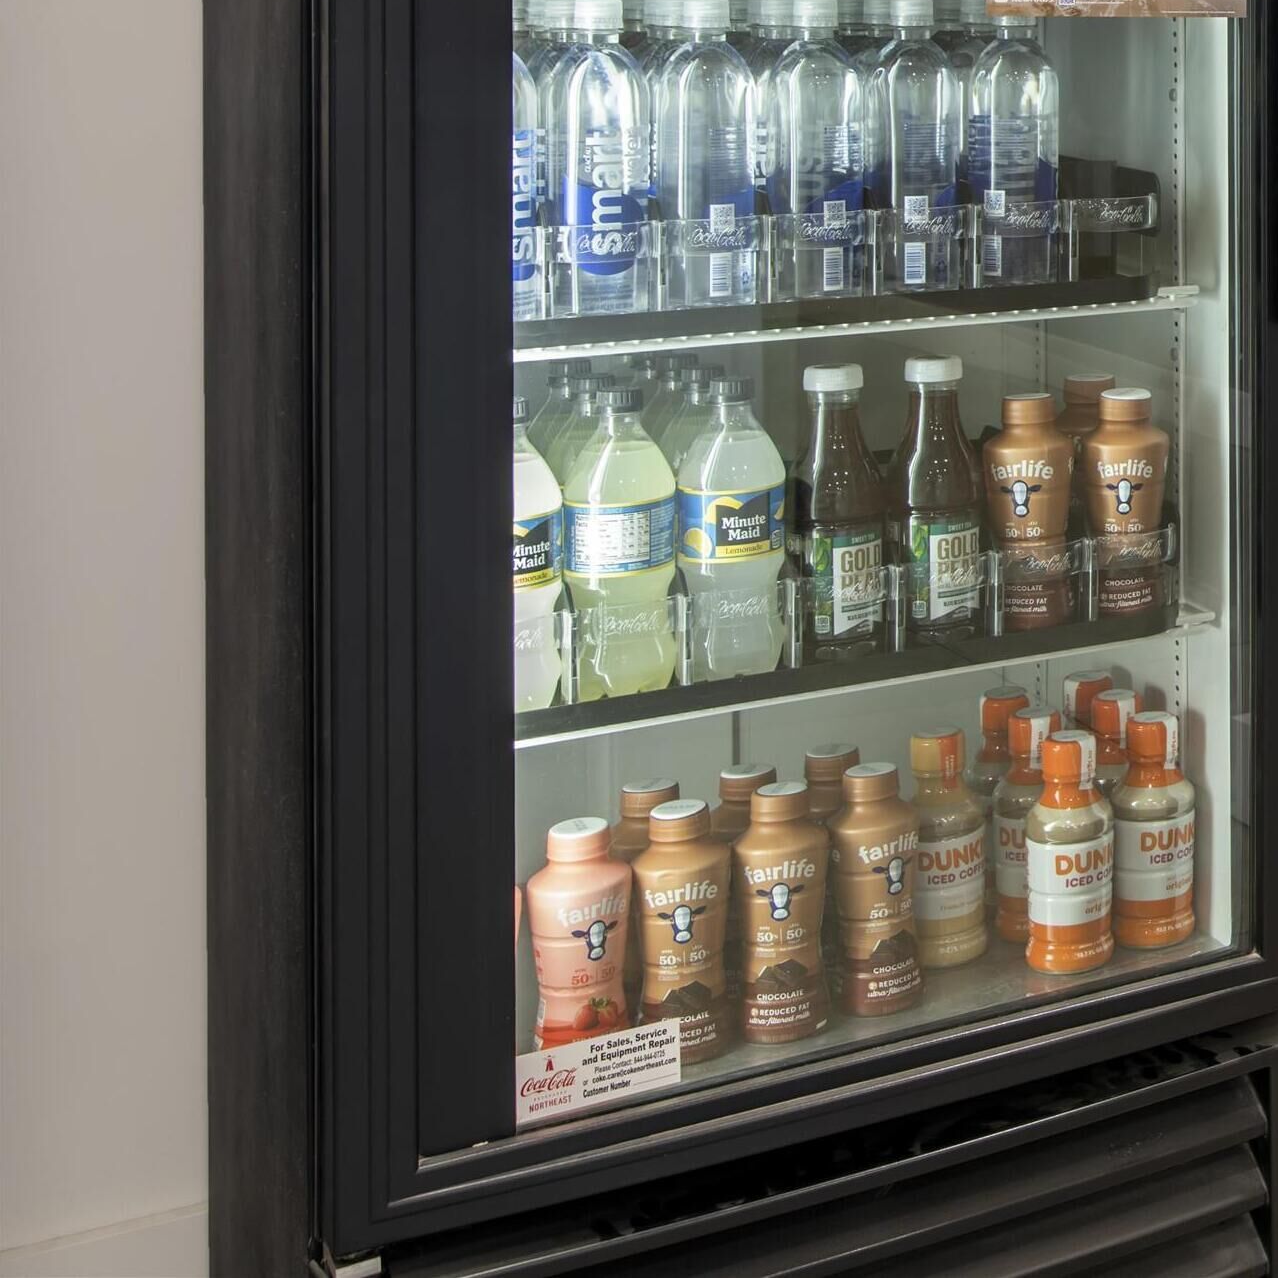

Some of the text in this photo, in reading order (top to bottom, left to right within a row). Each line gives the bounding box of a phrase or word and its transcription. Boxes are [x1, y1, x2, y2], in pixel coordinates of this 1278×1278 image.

[592, 131, 622, 255] smart
[721, 515, 767, 530] Minute
[728, 527, 761, 541] Maid
[938, 532, 978, 560] GOLD
[514, 555, 545, 570] Maid
[841, 544, 880, 573] GOLD
[1105, 578, 1144, 587] CHOCOLATE
[1109, 591, 1140, 600] REDUCED
[1150, 852, 1174, 865] ICED
[928, 874, 956, 885] ICED
[1065, 874, 1093, 889] ICED
[878, 974, 912, 988] REDUCED
[757, 989, 804, 1001] CHOCOLATE
[760, 1001, 810, 1017] REDUCED FAT
[590, 1028, 668, 1053] For Sales, Service
[582, 1036, 676, 1066] and Equipment Repair
[592, 1057, 677, 1084] coke.care@cokenortheast.com
[595, 1064, 611, 1074] Please
[612, 1059, 632, 1069] Contact:
[521, 1068, 577, 1097] Coca-Cola
[583, 1085, 608, 1098] Customer
[610, 1078, 631, 1092] Number
[529, 1095, 572, 1113] NORTHEAST
